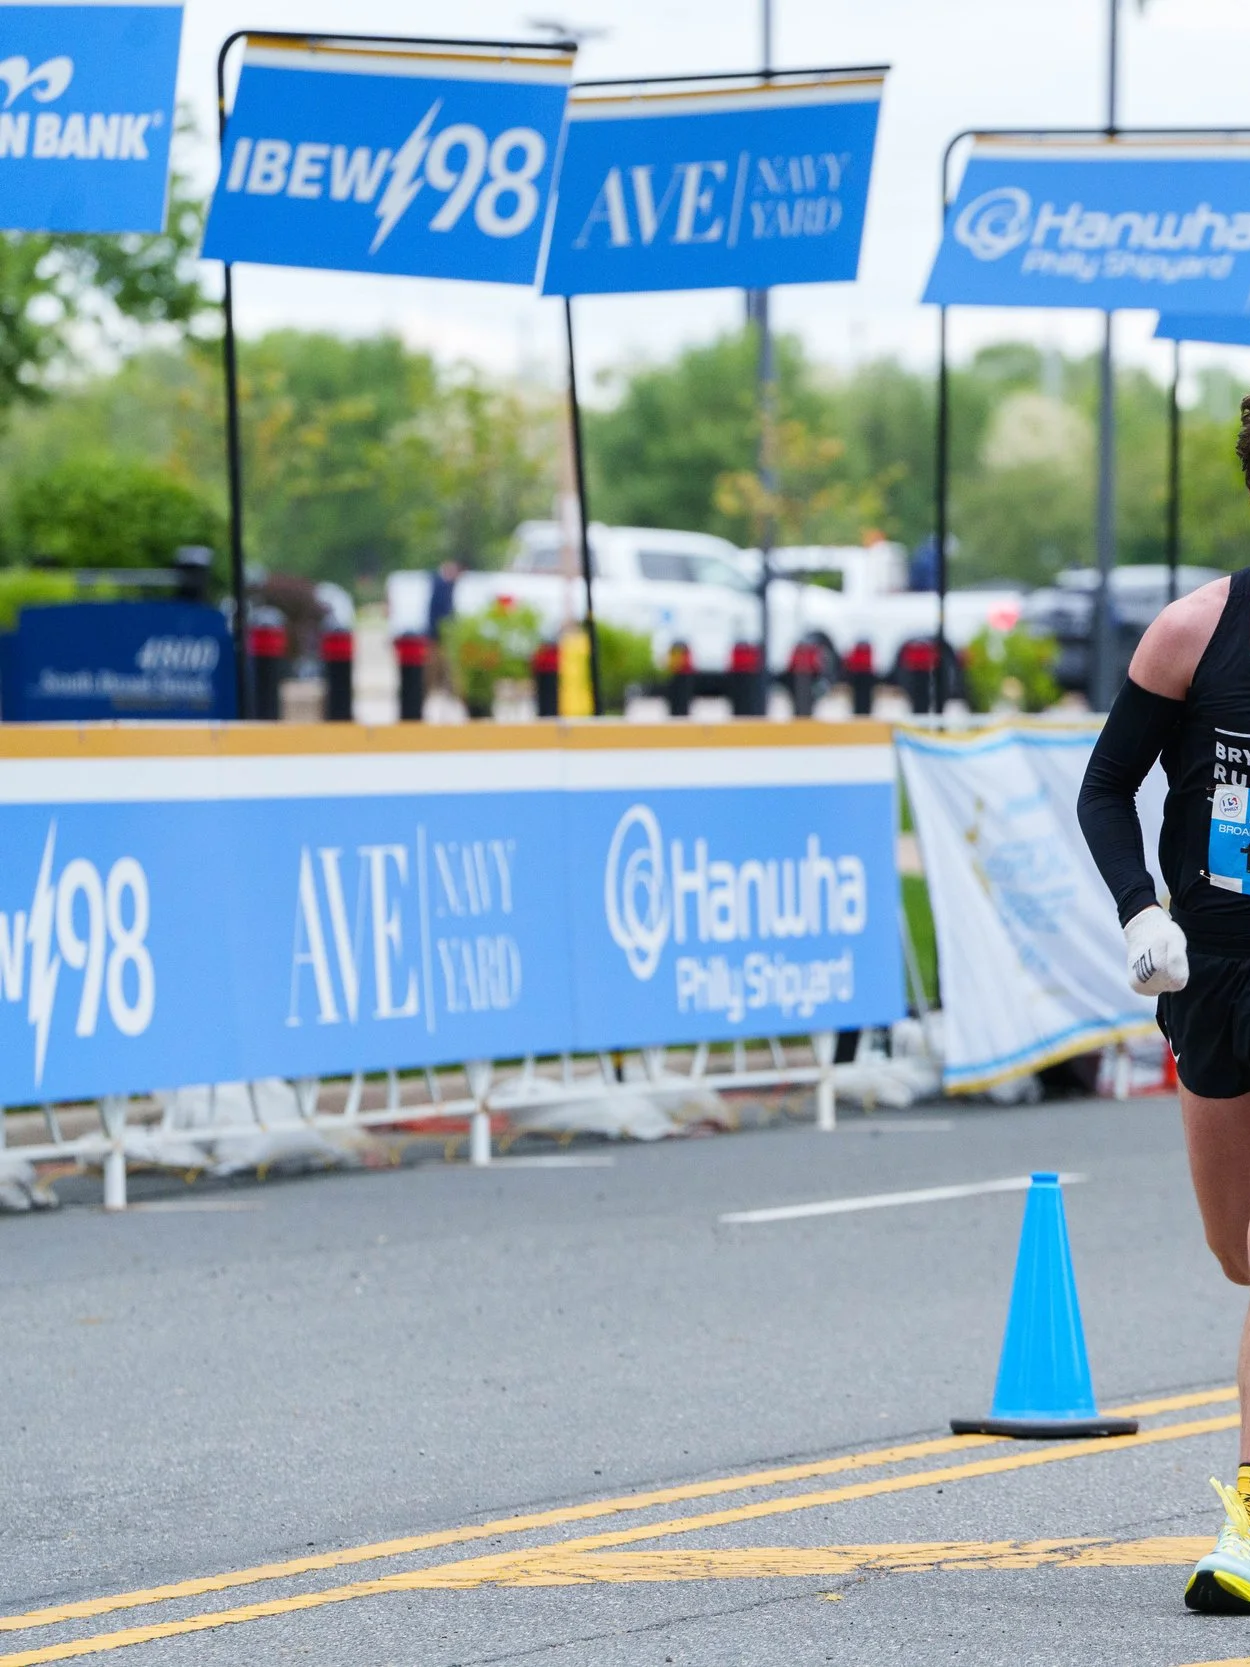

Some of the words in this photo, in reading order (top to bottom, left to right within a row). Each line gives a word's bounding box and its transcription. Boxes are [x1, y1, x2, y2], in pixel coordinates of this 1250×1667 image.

[32, 112, 151, 160] BANK
[754, 152, 850, 195] NAVY
[226, 137, 392, 203] IBEW
[425, 123, 547, 238] 98
[571, 160, 728, 249] AVE
[752, 196, 842, 239] YARD
[434, 838, 516, 918] NAVY
[670, 832, 868, 945] Hanwha
[55, 857, 156, 1037] 98
[285, 844, 419, 1027] AVE
[437, 934, 522, 1013] YARD
[676, 955, 745, 1023] Philly
